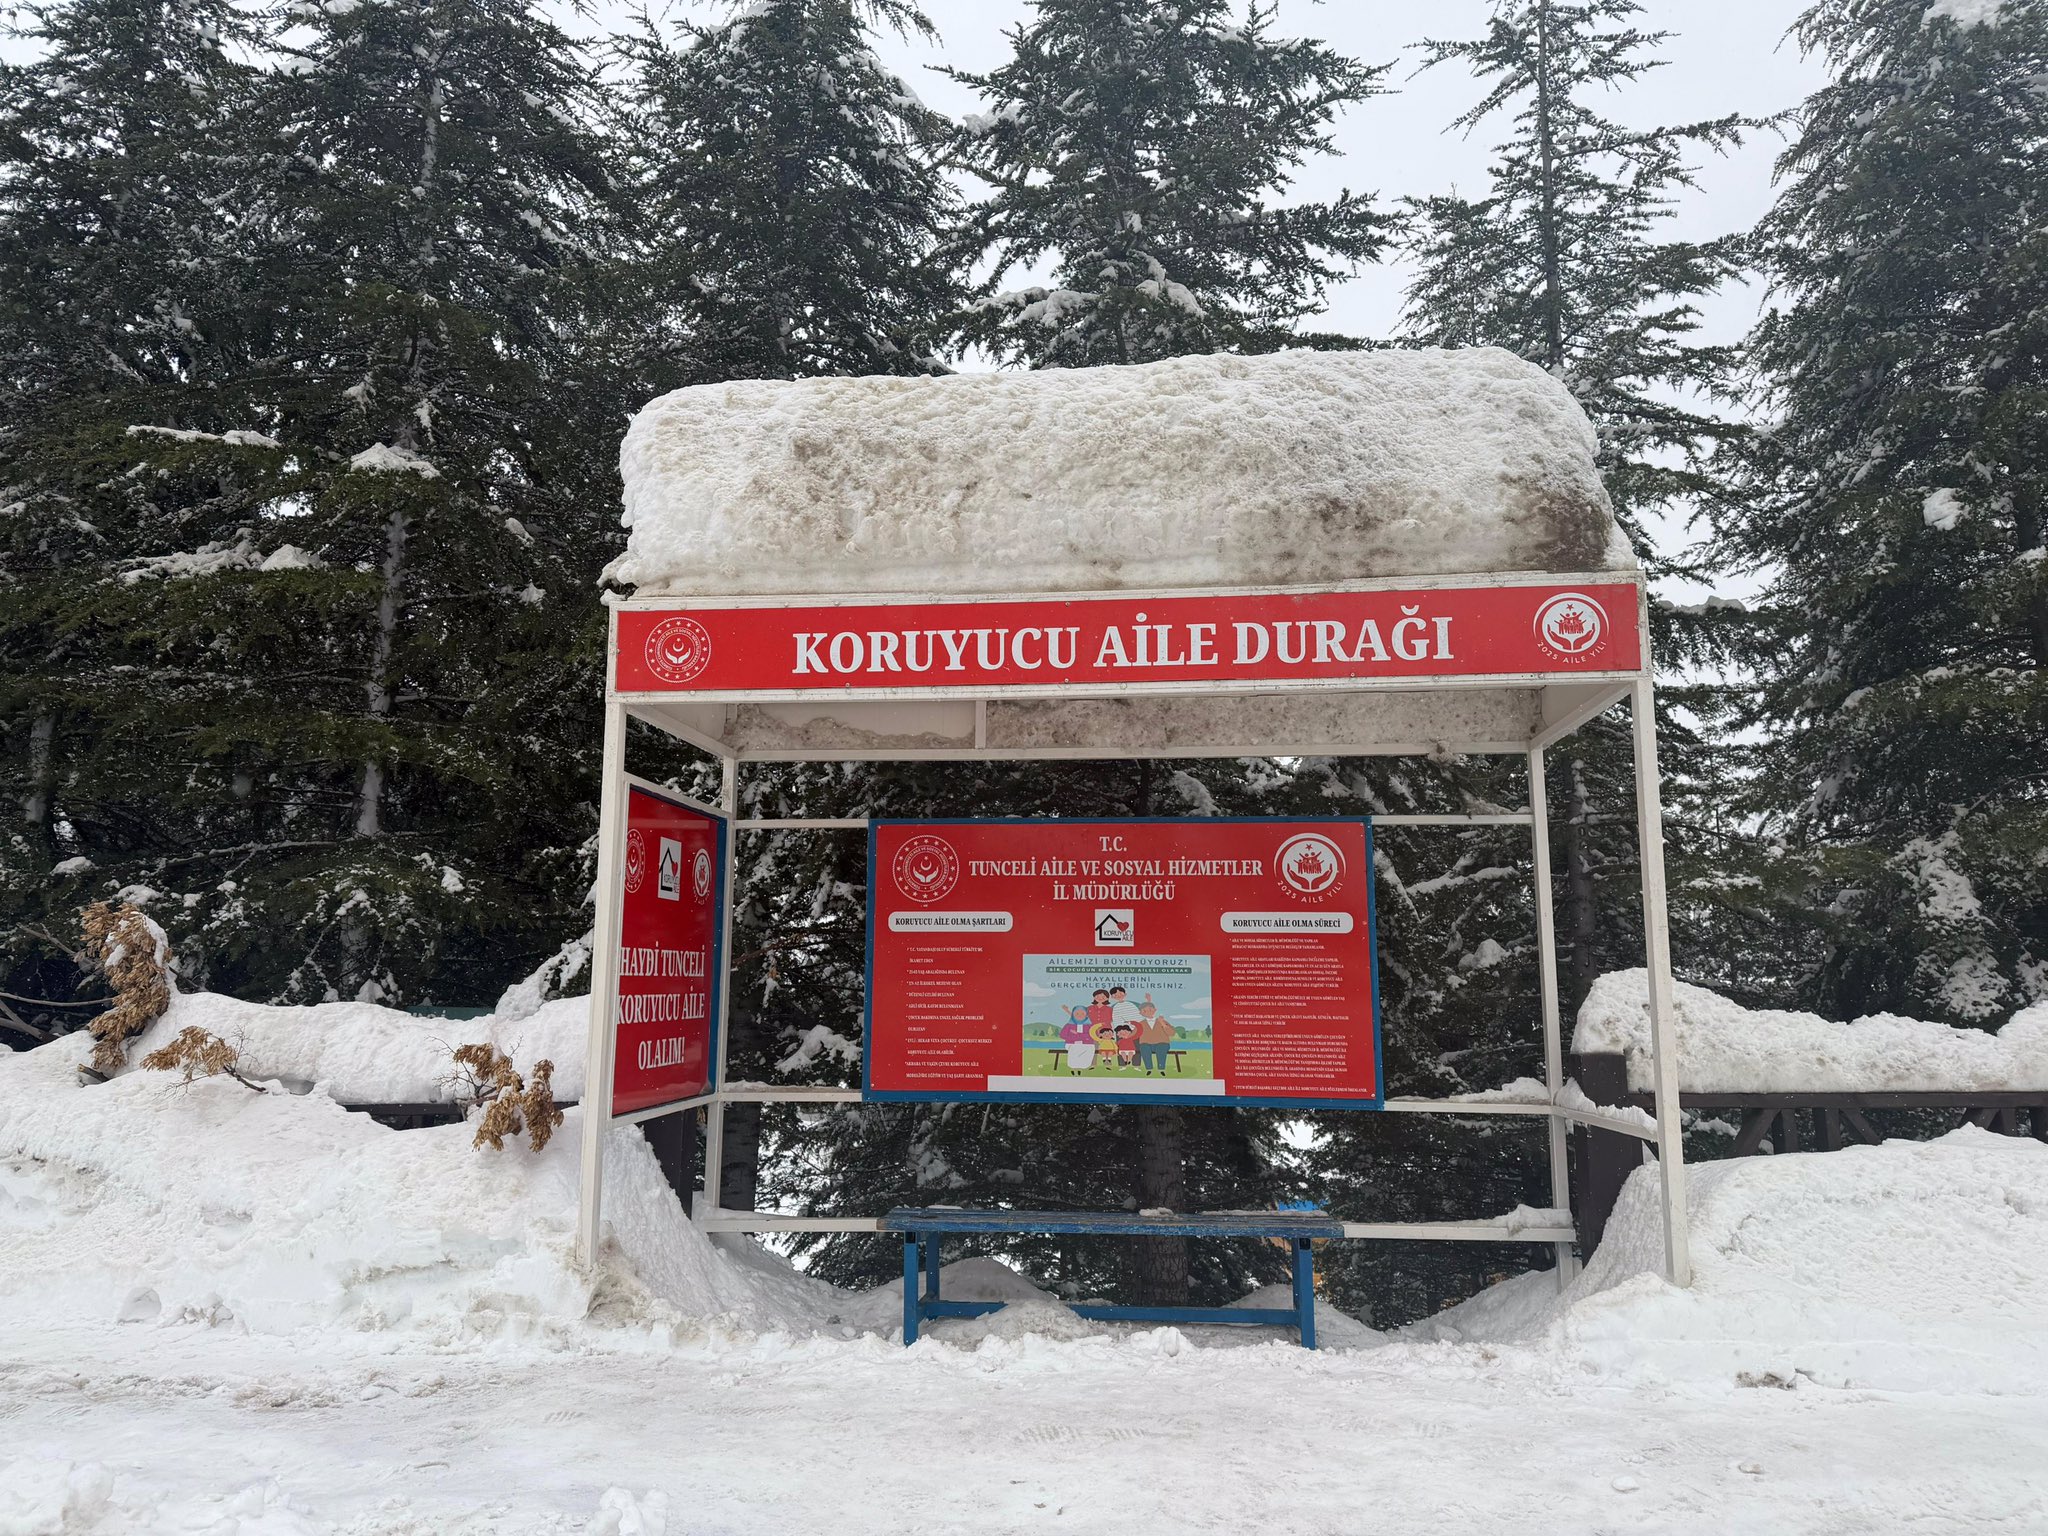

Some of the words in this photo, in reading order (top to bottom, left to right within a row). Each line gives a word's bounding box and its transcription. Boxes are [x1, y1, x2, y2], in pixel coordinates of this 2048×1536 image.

[792, 626, 1080, 674] KORUYUCU
[1093, 612, 1219, 667] AİLE
[1232, 604, 1454, 665] DURAĞI
[1537, 640, 1558, 660] 2025
[1563, 655, 1587, 664] AİLE
[1589, 641, 1607, 657] YILI
[1099, 836, 1128, 852] T.C.
[969, 856, 1037, 876] TUNCELİ
[1040, 856, 1077, 876] AİLE
[1080, 860, 1101, 876] VE
[1104, 860, 1165, 876] SOSYAL
[1168, 856, 1263, 876] HİZMETLER
[1053, 880, 1069, 900] İL
[1073, 879, 1175, 900] MÜDÜRLÜĞÜ
[1277, 880, 1297, 899] 2025
[1301, 895, 1324, 903] AİLE
[1326, 881, 1344, 898] YILI
[895, 918, 933, 926] KORUYUCU
[934, 916, 950, 926] AİLE
[951, 918, 971, 926] OLMA
[972, 918, 1006, 927] ŞARTLARI
[1232, 919, 1273, 928] KORUYUCU
[1273, 917, 1291, 928] AİLE
[1291, 919, 1313, 928] OLMA
[1314, 918, 1341, 928] SÜRECİ
[619, 940, 659, 977] HAYDİ
[661, 944, 705, 977] TUNCELİ
[1103, 958, 1188, 966] BÜYÜTÜYORUZ!
[617, 993, 681, 1025] KORUYUCU
[682, 985, 705, 1020] AİLE
[638, 1036, 686, 1071] OLALIM!
